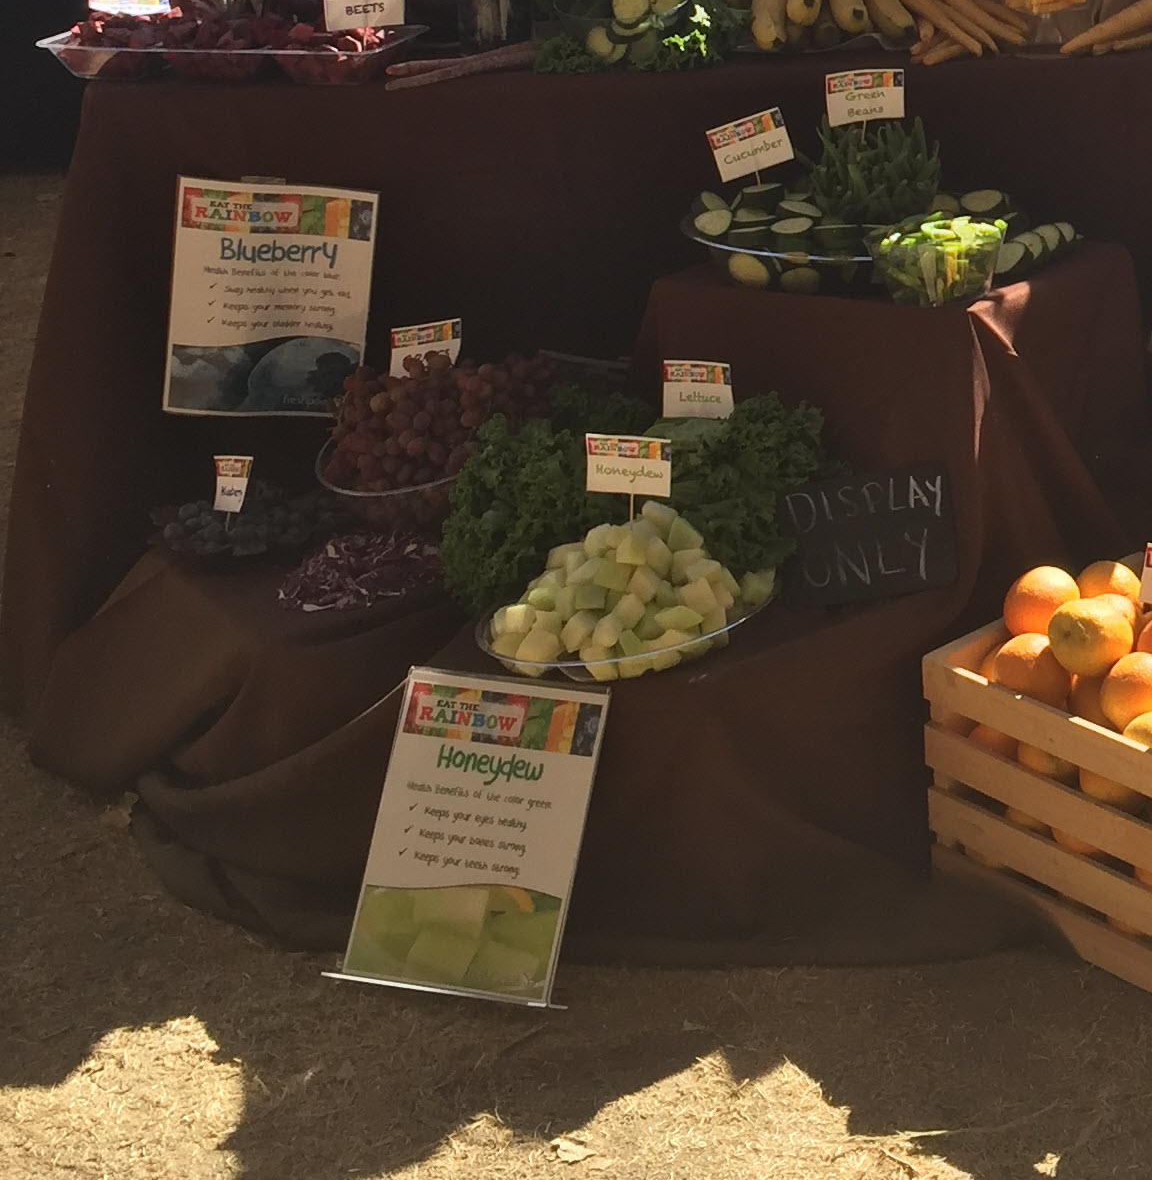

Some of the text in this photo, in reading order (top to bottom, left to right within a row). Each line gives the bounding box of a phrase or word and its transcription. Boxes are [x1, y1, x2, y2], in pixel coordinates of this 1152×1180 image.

[345, 2, 385, 15] BEETS
[845, 90, 886, 101] Green
[847, 106, 884, 116] Beans
[724, 138, 783, 165] Cucumber
[195, 206, 293, 223] RAINBOW
[220, 237, 338, 269] Blueberry
[679, 391, 722, 404] Lettuce
[595, 463, 663, 483] Honeydew
[786, 475, 942, 533] DISPLAY
[803, 528, 928, 588] ONLY
[436, 700, 479, 711] EAT THE
[420, 706, 517, 731] RAINBOW
[437, 744, 544, 786] Honeydew
[424, 806, 449, 820] Keeps
[452, 812, 471, 823] your
[474, 814, 494, 827] eyes
[419, 828, 444, 843] Keeps
[448, 834, 466, 845] your
[498, 840, 526, 857] strong
[414, 851, 439, 866] Keeps
[442, 856, 462, 868] your
[491, 862, 520, 879] strong
